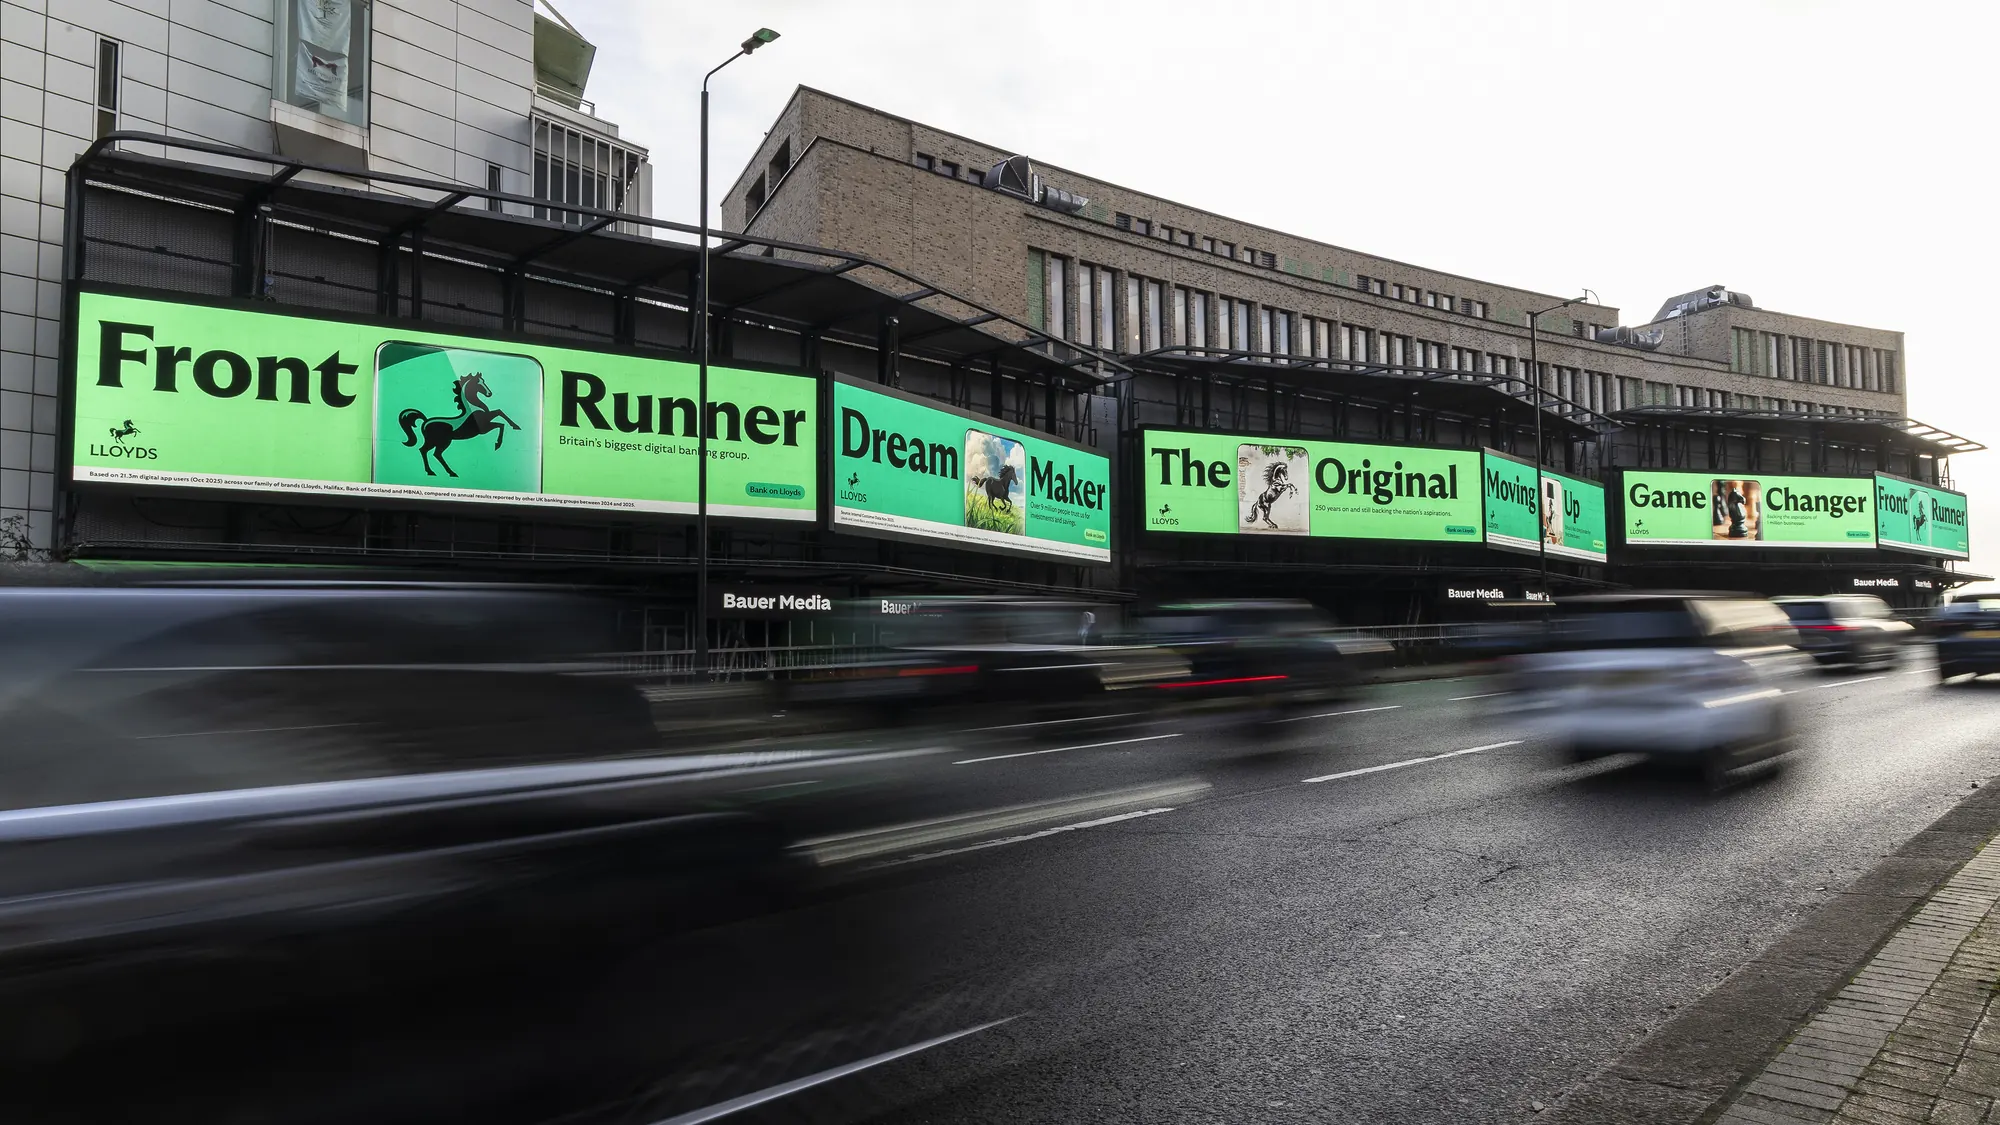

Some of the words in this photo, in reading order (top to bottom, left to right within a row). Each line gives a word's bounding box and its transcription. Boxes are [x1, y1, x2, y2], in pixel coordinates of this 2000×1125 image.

[96, 319, 359, 408] Front
[560, 370, 806, 447] Runner
[90, 443, 158, 460] LLOYDS
[559, 436, 602, 448] Britain's
[604, 439, 642, 452] biggest
[645, 443, 676, 455] digital
[678, 446, 718, 459] banng
[720, 450, 750, 461] group.
[841, 406, 959, 481] Dream
[1030, 455, 1106, 511] Maker
[254, 480, 272, 488] family
[1151, 447, 1231, 489] The
[1315, 457, 1459, 505] Original
[750, 486, 768, 494] Bank
[780, 487, 802, 497] Lloyds
[840, 490, 867, 503] LLOYDS
[1486, 468, 1536, 515] Moving
[1564, 490, 1580, 524] Up
[1629, 483, 1707, 510] Game
[1766, 487, 1867, 519] Changer
[1878, 485, 1908, 516] Front
[1931, 497, 1966, 526] Runner
[1372, 507, 1392, 516] backing
[1152, 517, 1179, 526] LLOYDS
[1854, 578, 1876, 587] Bauer
[1876, 578, 1899, 587] Media
[723, 593, 775, 610] Bauer
[779, 595, 832, 611] Media
[1448, 588, 1475, 599] Bauer
[1476, 588, 1504, 599] Media
[881, 600, 911, 615] Bauer
